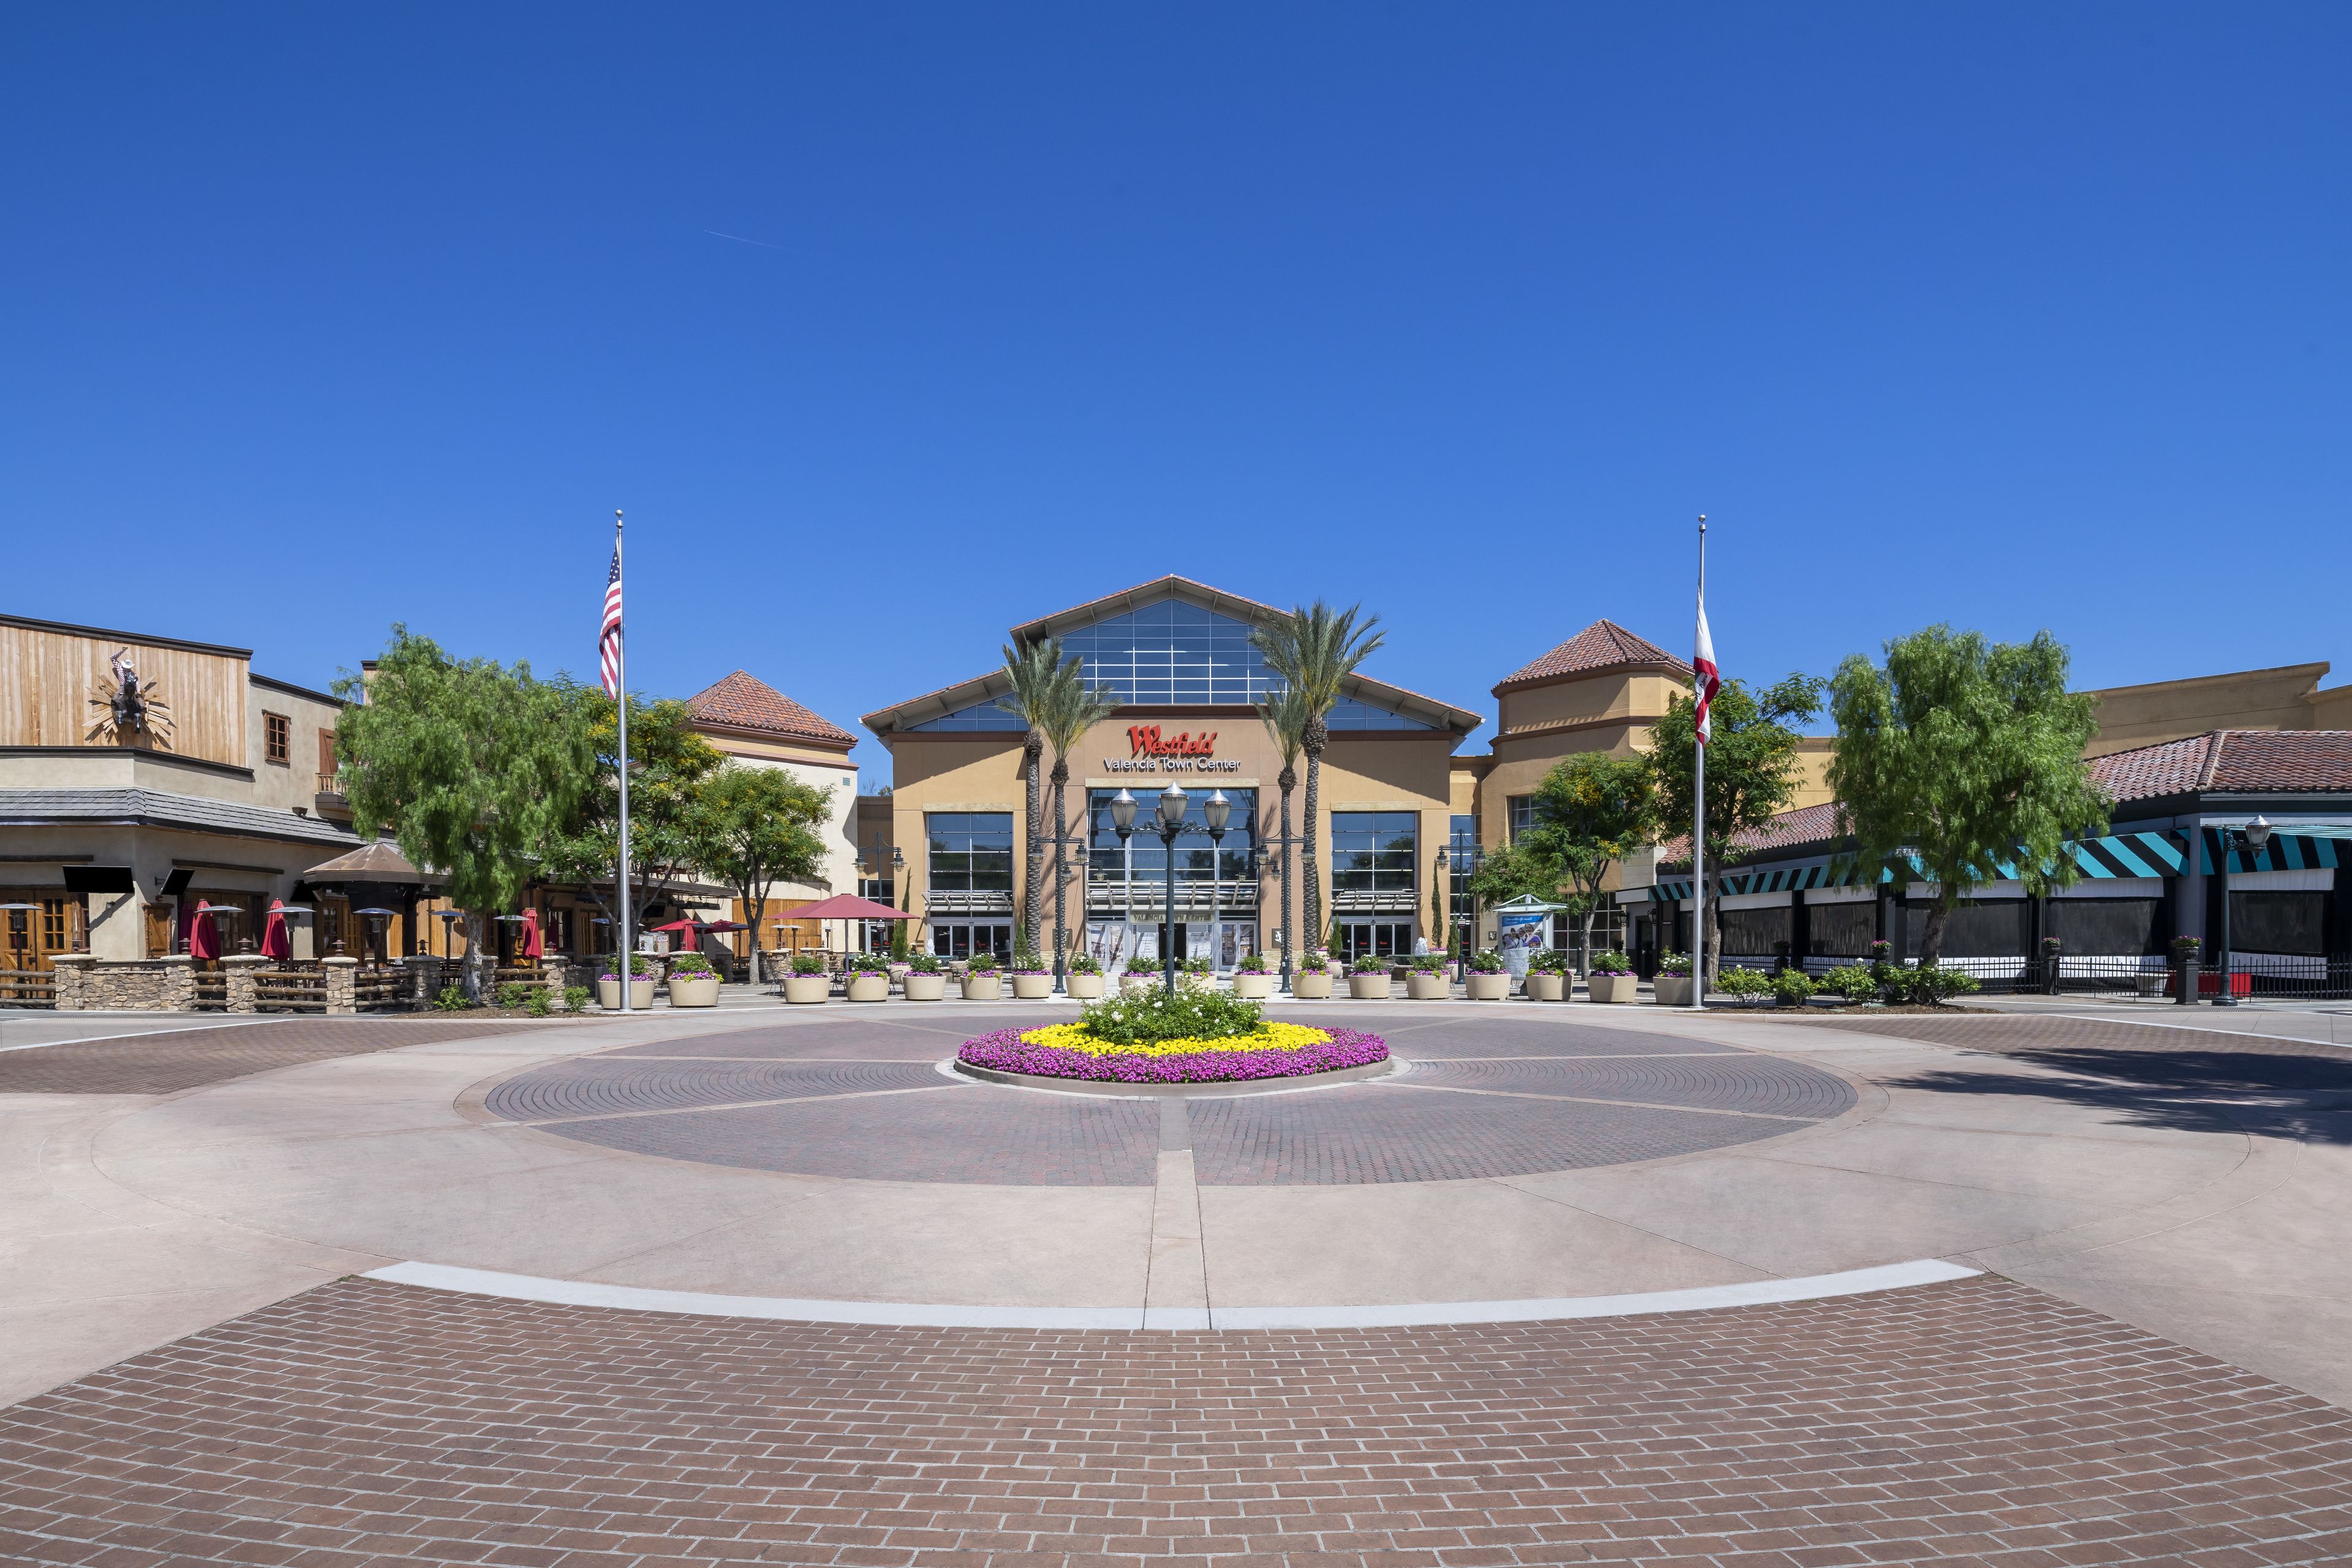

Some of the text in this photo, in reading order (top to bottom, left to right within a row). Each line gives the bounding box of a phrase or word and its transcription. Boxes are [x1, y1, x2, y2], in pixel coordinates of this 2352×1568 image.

[1128, 725, 1218, 754] Westfield
[1104, 757, 1242, 768] Valencia Town Center
